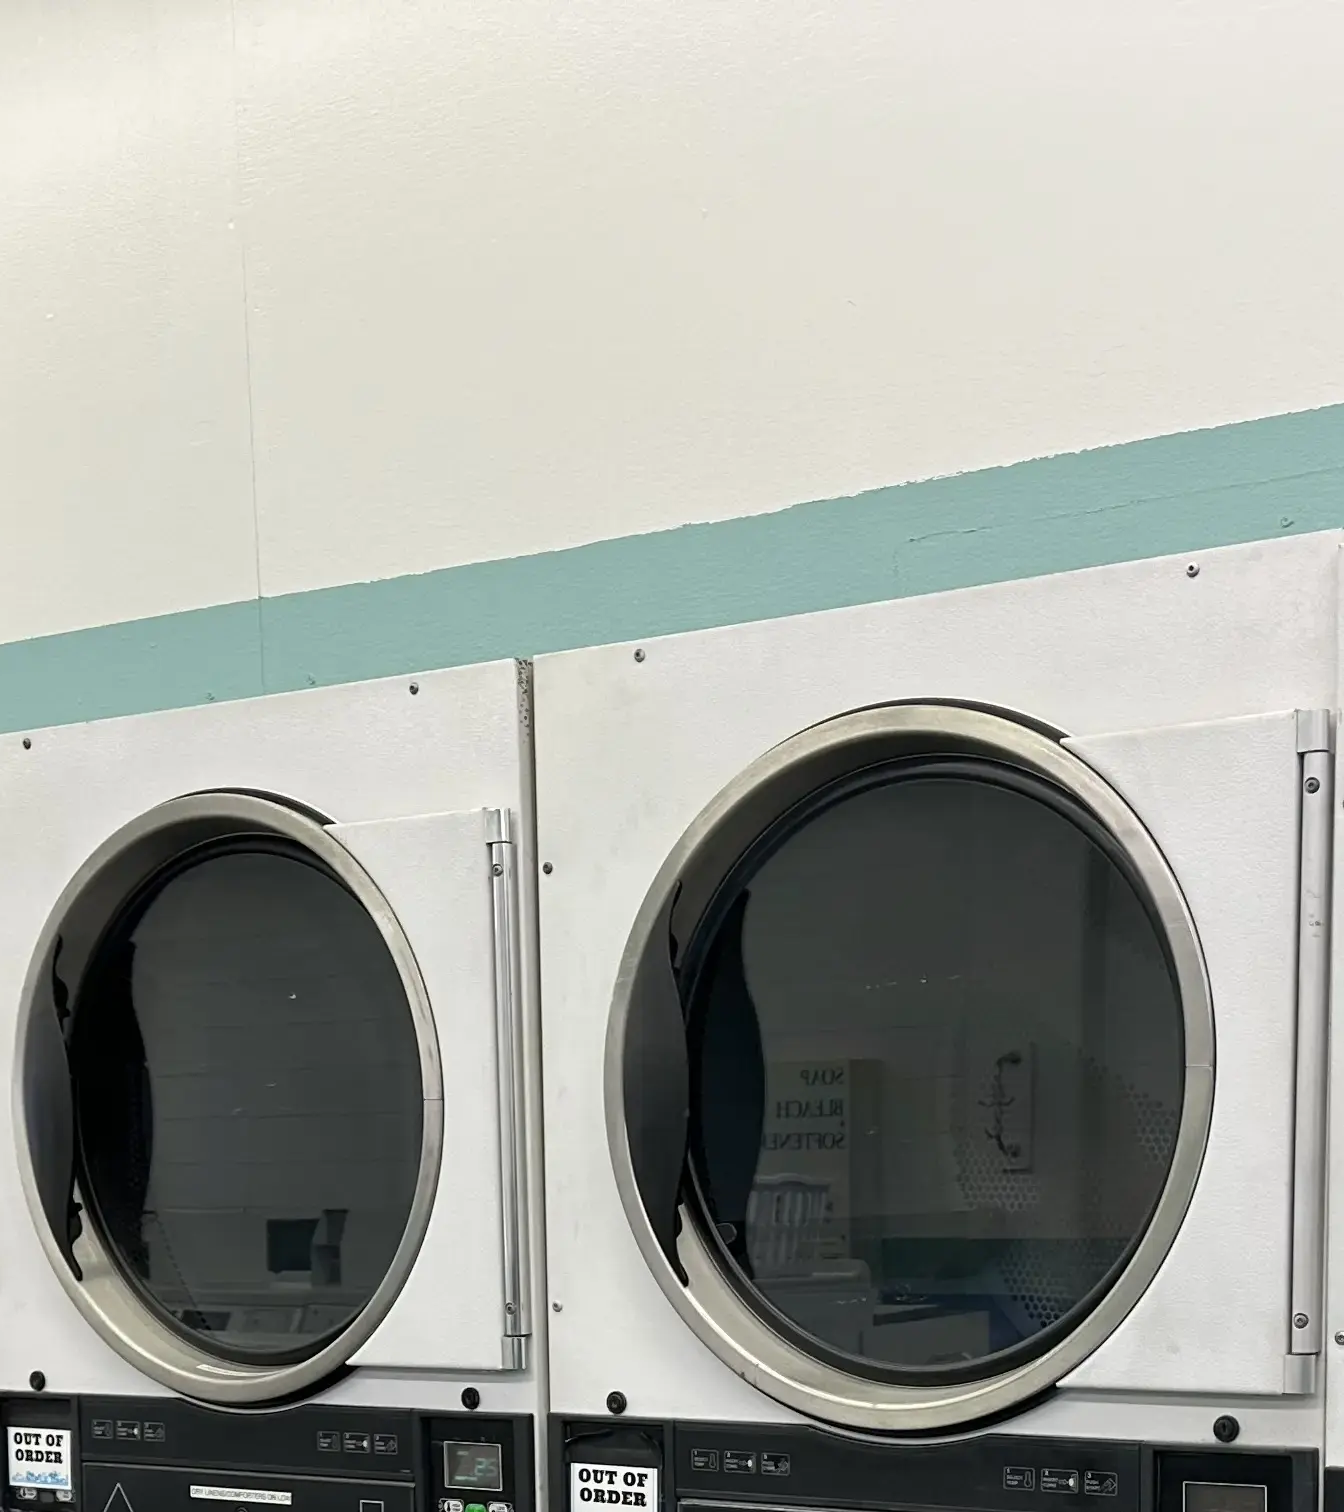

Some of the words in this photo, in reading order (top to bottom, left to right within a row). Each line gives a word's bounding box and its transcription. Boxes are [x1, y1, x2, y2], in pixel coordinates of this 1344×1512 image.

[14, 1432, 41, 1445] OUT
[46, 1434, 63, 1447] OF
[16, 1449, 63, 1464] ORDER
[578, 1468, 617, 1484] OUT
[623, 1472, 648, 1487] OF
[580, 1487, 647, 1507] ORDER
